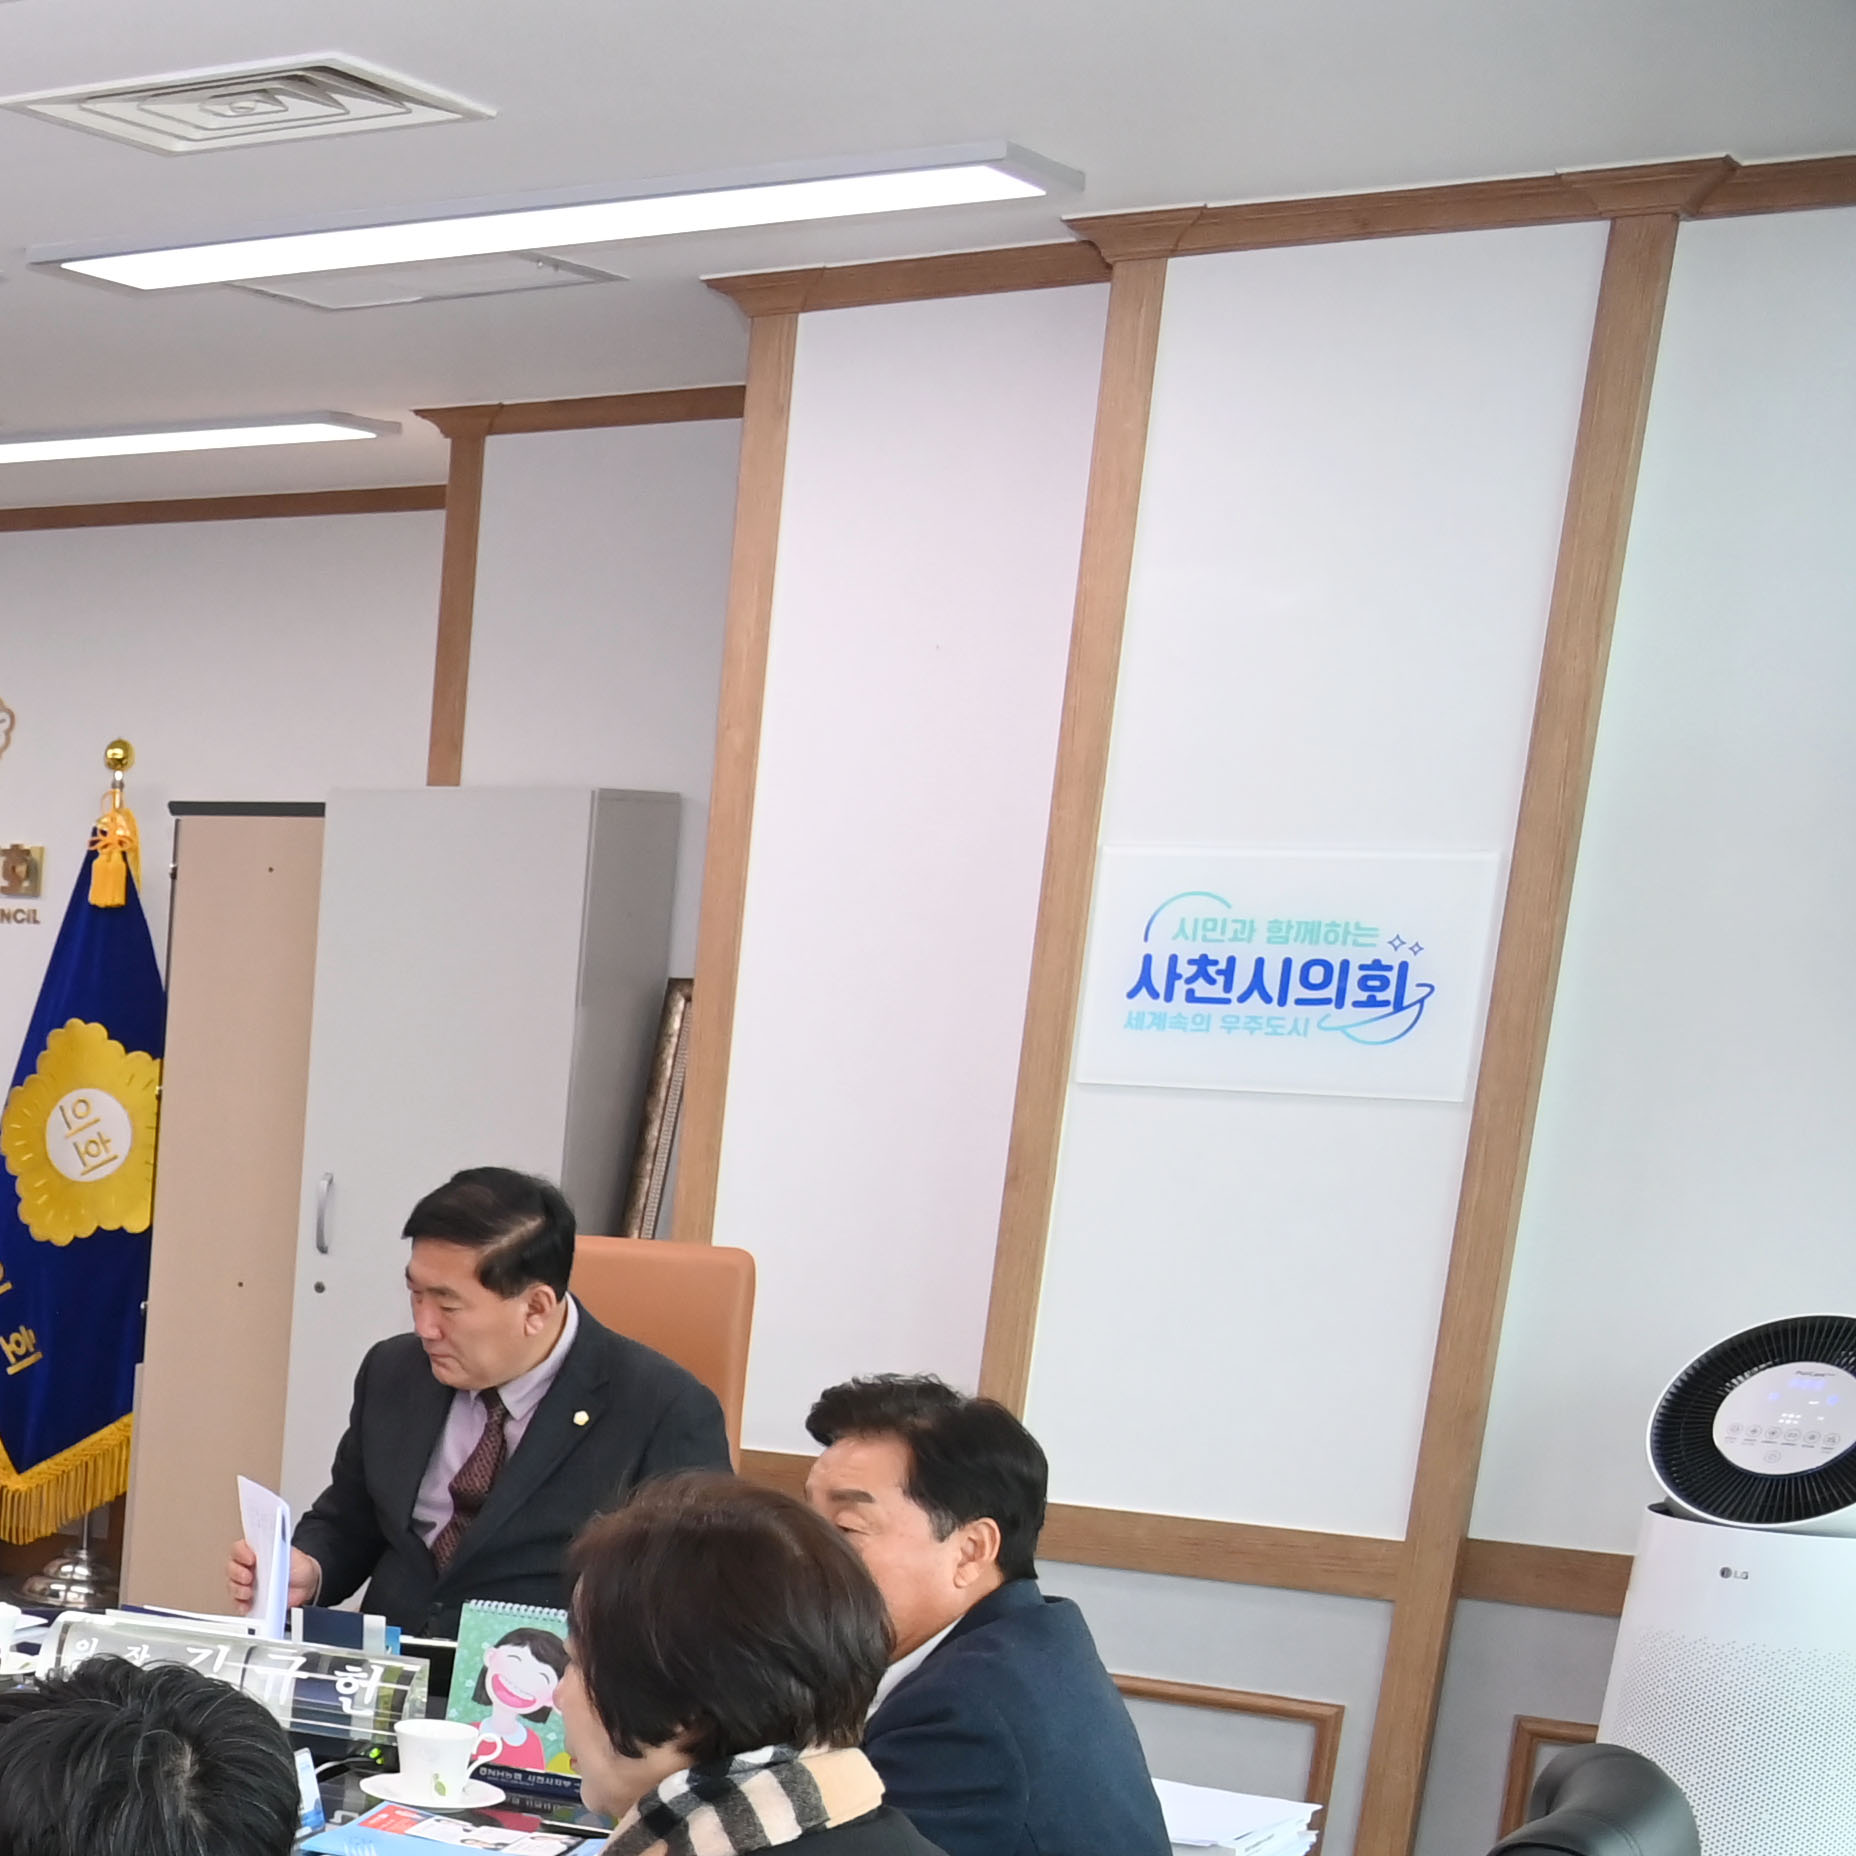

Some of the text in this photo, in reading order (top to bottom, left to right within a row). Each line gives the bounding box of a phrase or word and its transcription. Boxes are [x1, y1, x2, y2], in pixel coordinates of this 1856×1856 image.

[1172, 915, 1380, 948] 시민과 함께하는
[1126, 953, 1410, 1012] 사천시의회
[1122, 1009, 1310, 1038] 세계속의 우주도시
